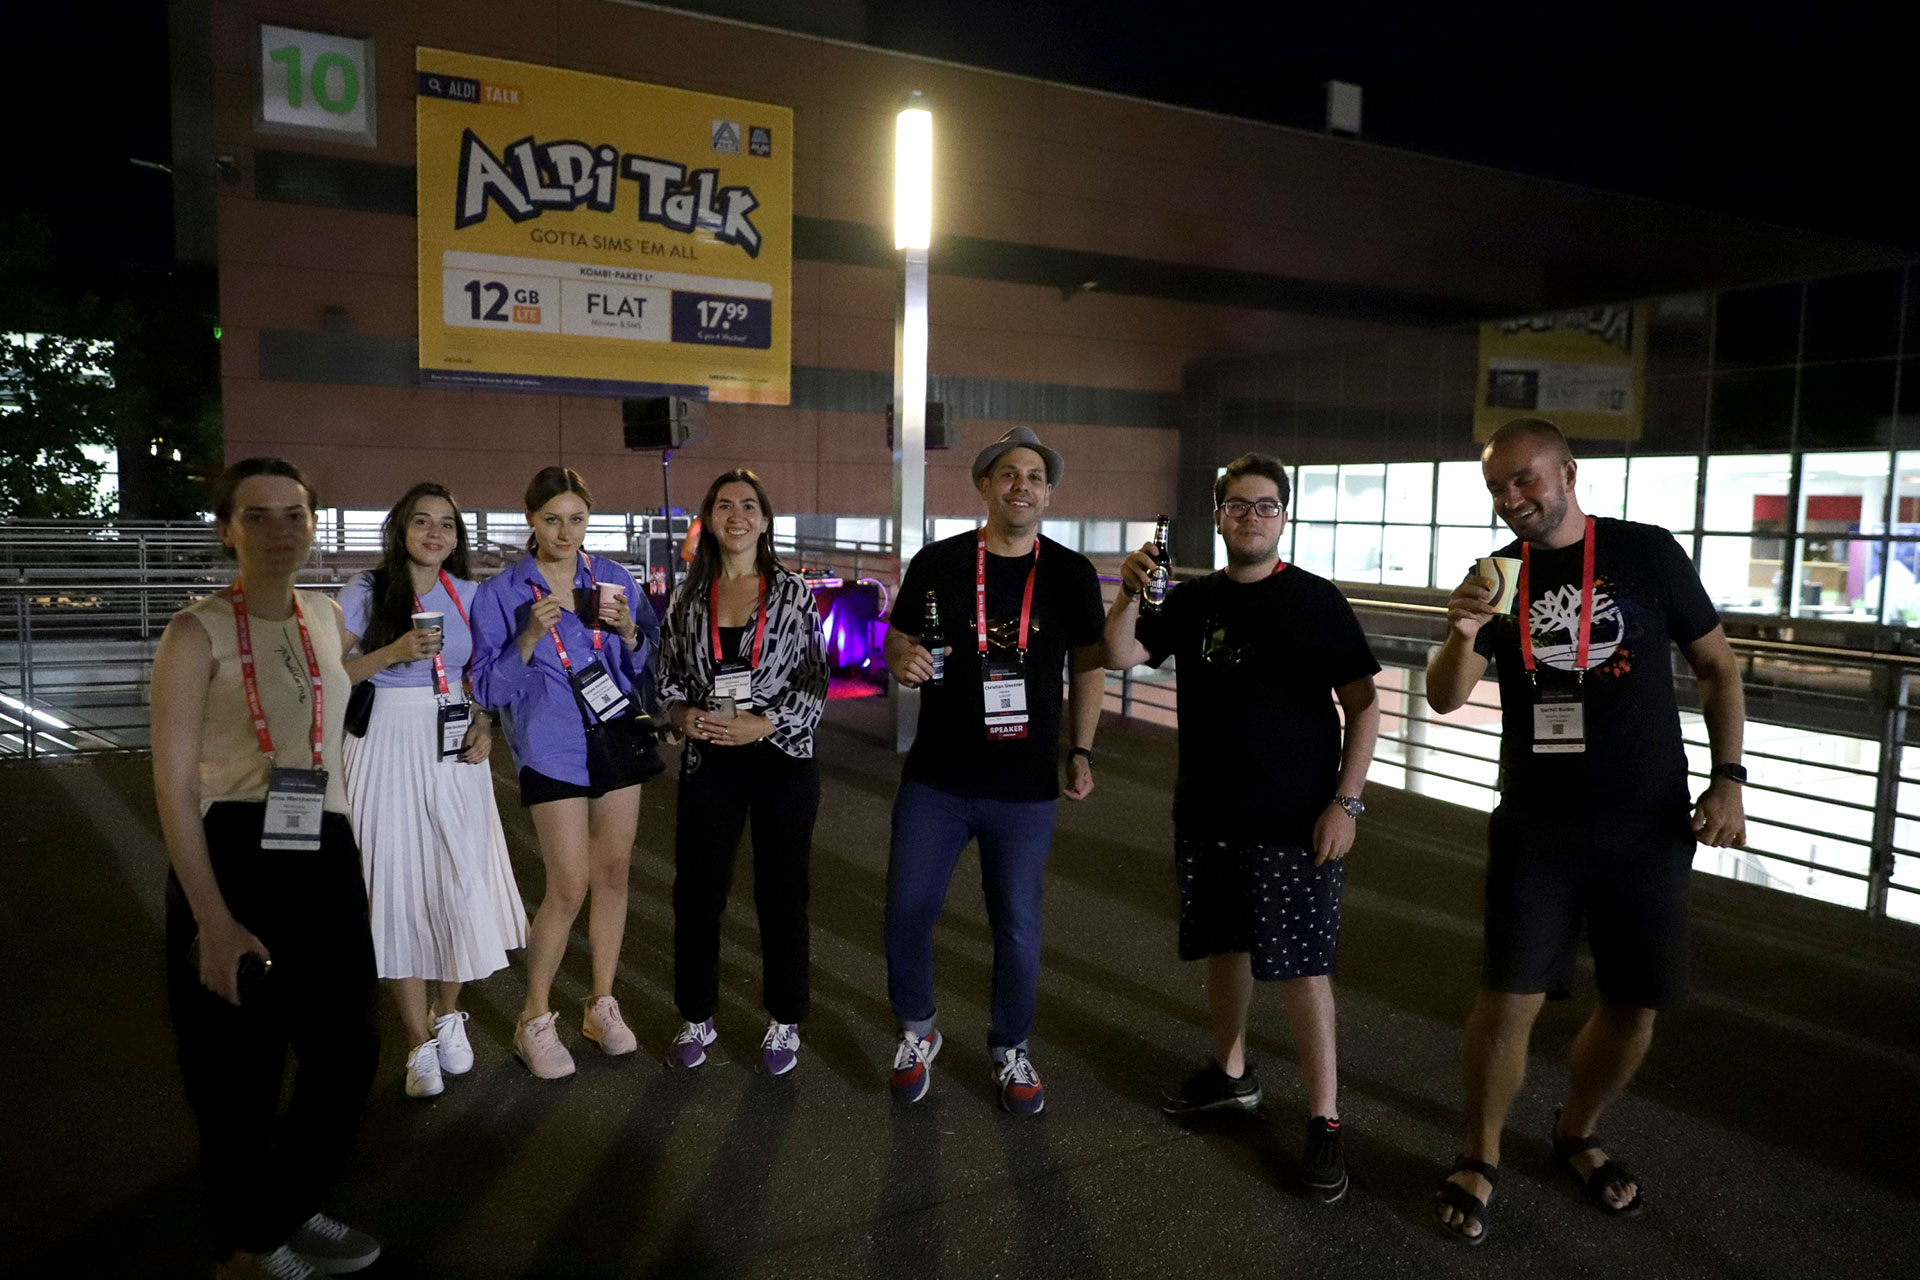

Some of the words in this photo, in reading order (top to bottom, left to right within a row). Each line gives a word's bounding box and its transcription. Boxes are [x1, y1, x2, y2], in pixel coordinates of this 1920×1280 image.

[269, 46, 359, 114] 10
[449, 81, 475, 98] ALDI
[485, 86, 519, 104] TALK
[530, 227, 588, 249] GOTTA
[593, 234, 632, 252] SIMS
[669, 244, 698, 260] ALL
[580, 267, 644, 282] KOMBI-PAKET
[464, 280, 509, 322] 12
[514, 289, 539, 305] GB
[587, 293, 647, 318] FLAT
[516, 309, 538, 321] LTE
[990, 724, 1024, 734] SPEAKER
